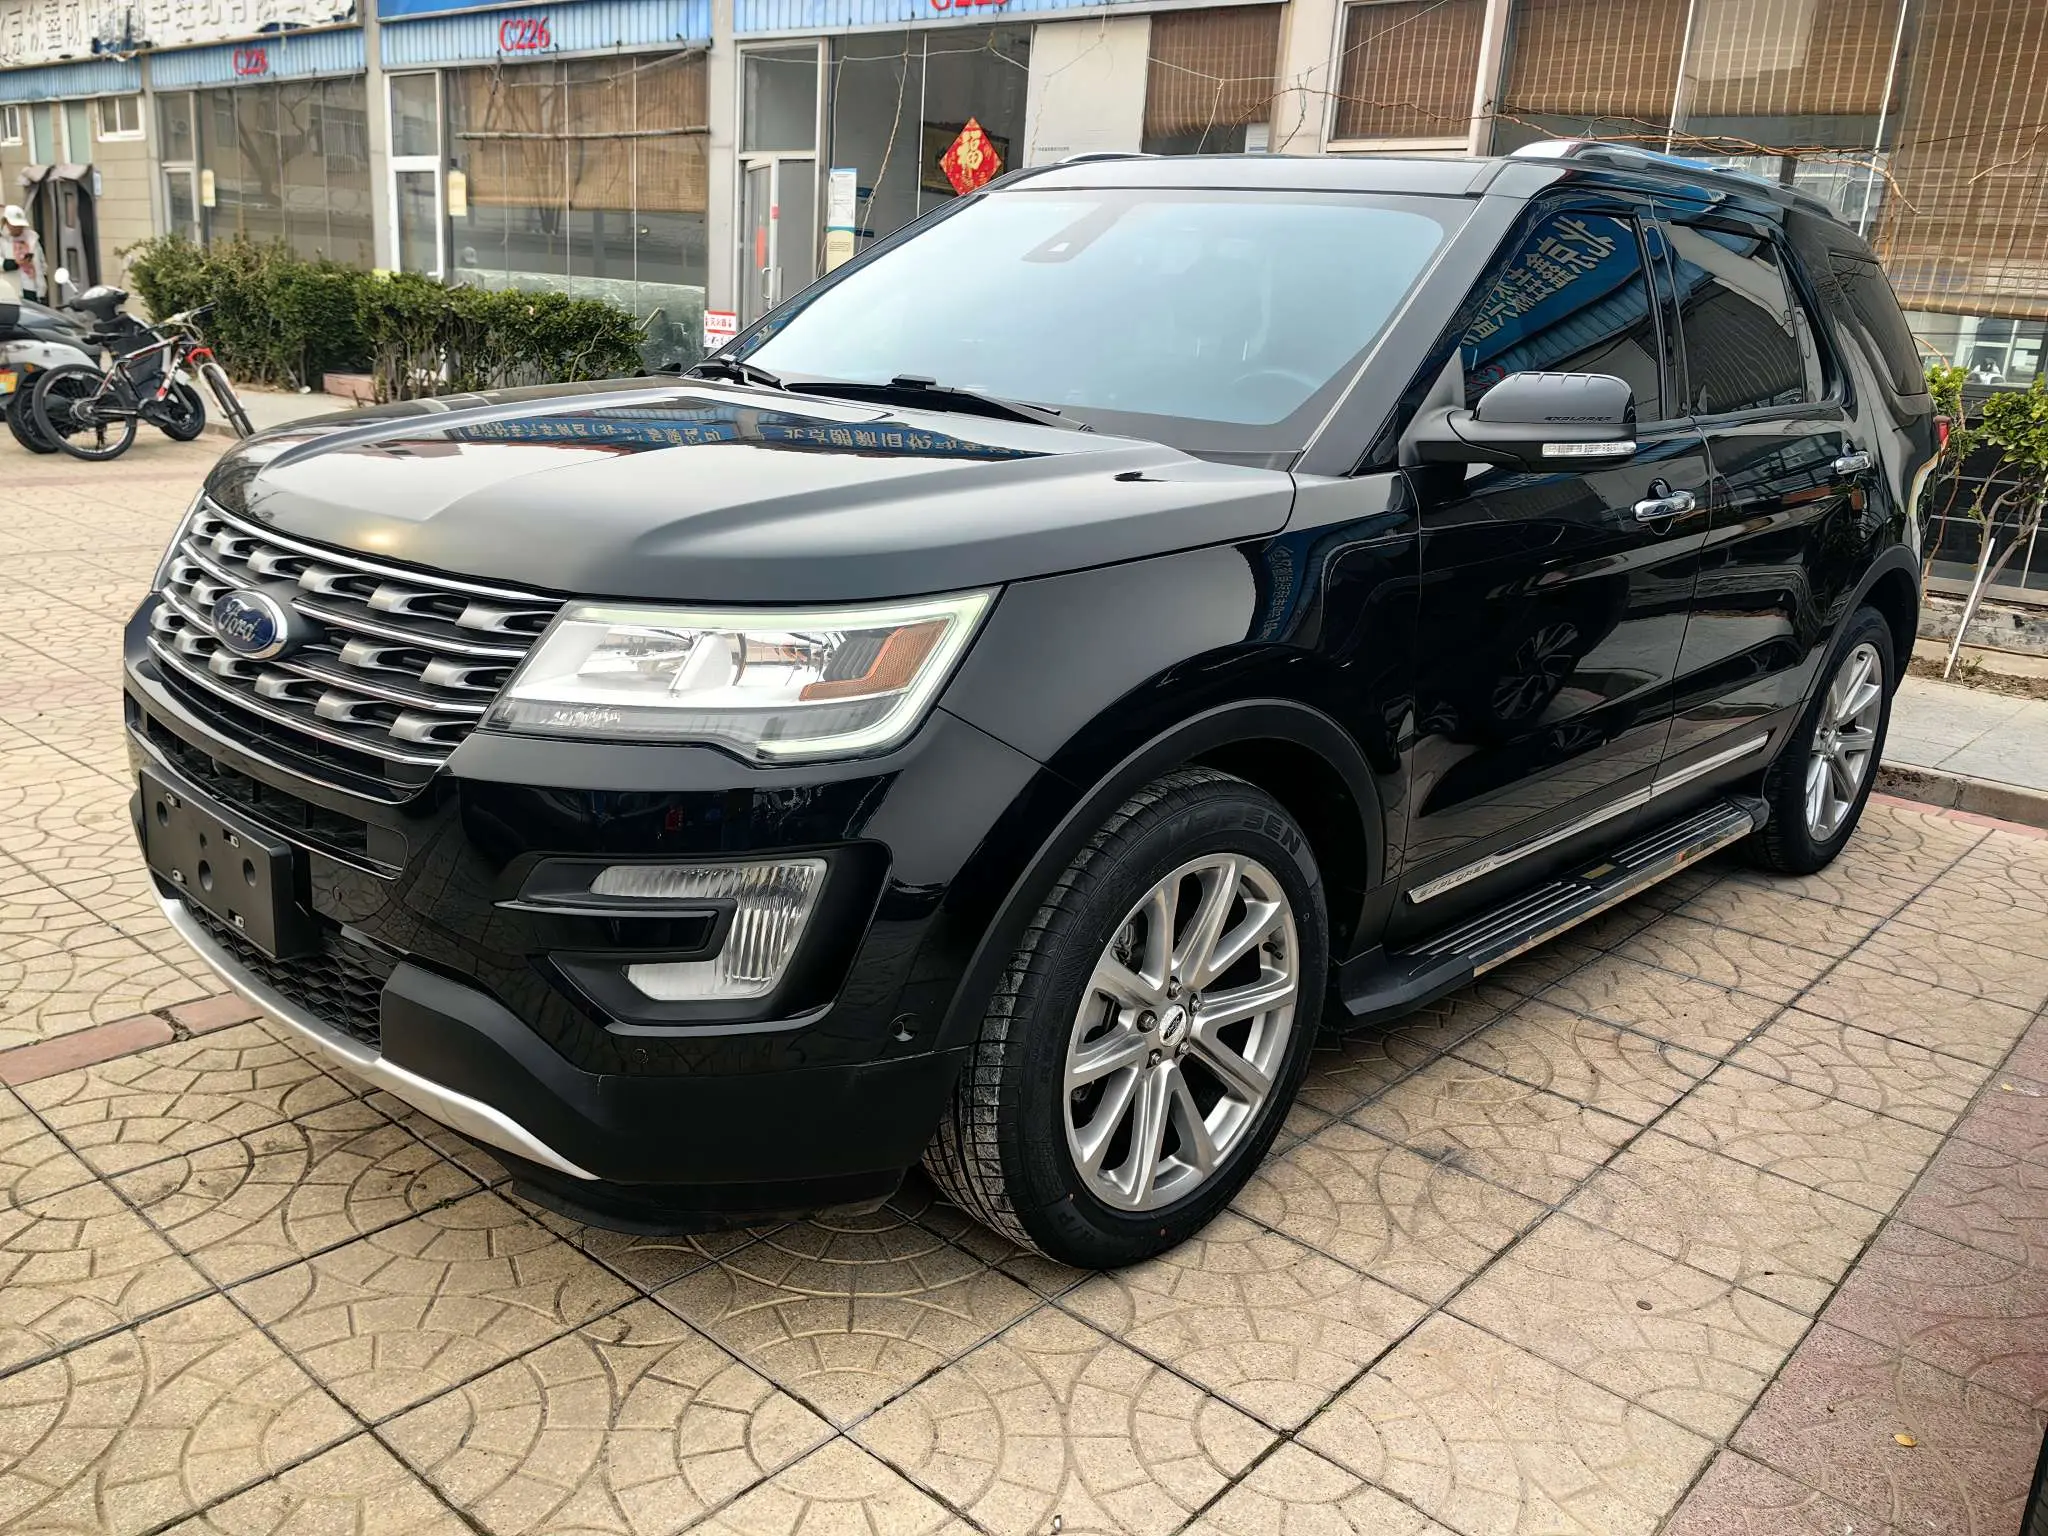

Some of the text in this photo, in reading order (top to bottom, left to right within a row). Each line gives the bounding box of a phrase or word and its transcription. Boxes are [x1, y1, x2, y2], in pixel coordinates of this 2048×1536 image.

[499, 16, 550, 52] C226
[956, 130, 983, 170] 福
[219, 598, 262, 642] Ford
